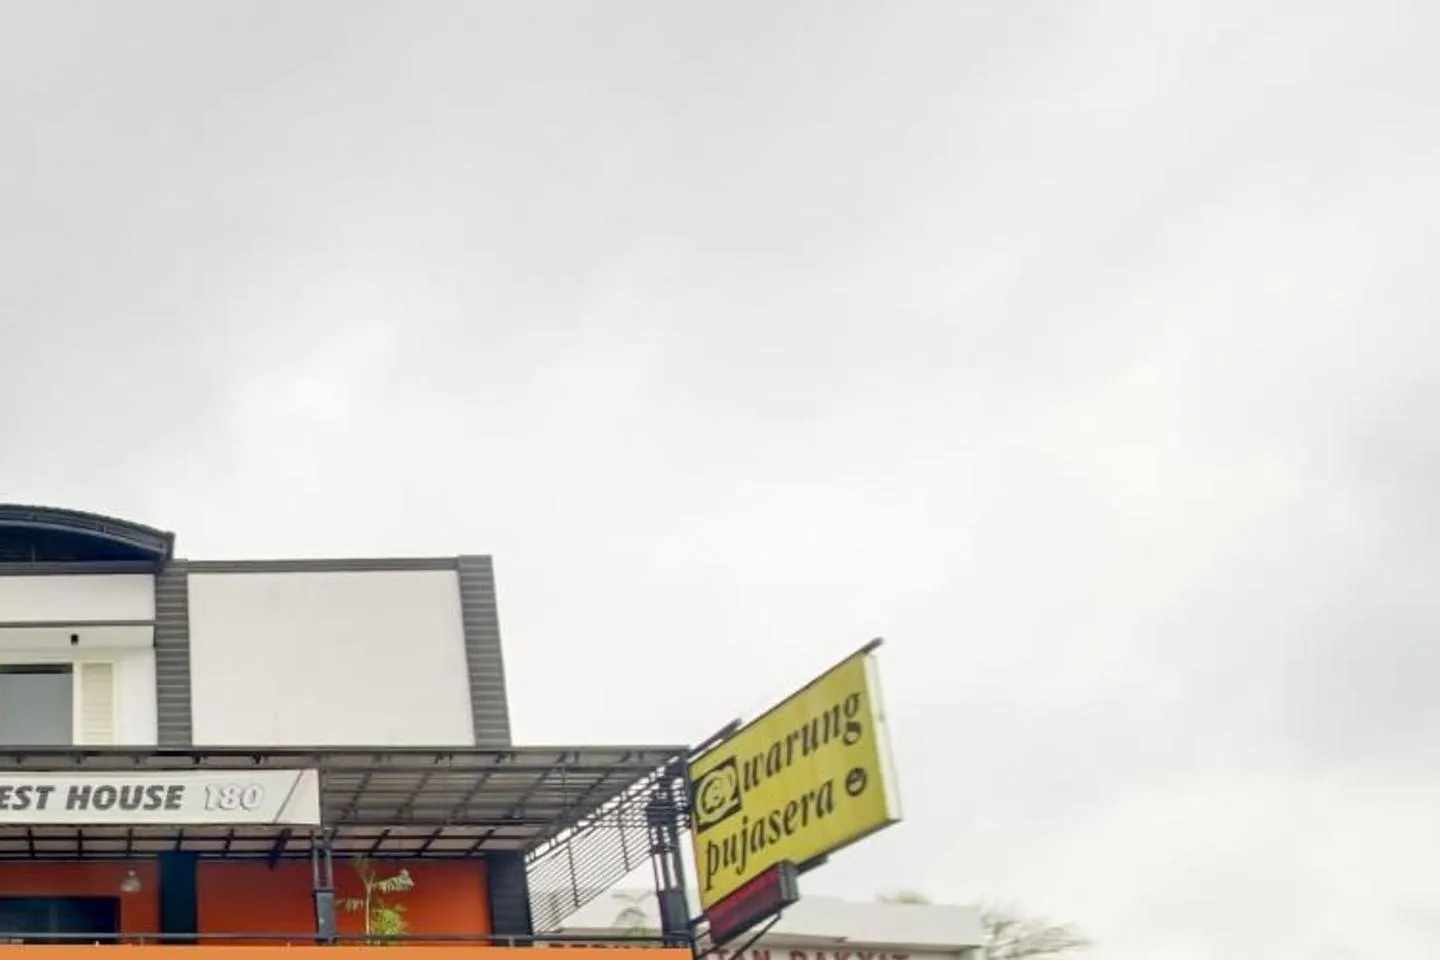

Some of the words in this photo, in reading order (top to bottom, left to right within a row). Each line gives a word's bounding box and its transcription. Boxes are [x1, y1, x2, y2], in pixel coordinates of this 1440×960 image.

[743, 691, 863, 792] warung
[65, 785, 185, 810] HOUSE
[203, 783, 265, 811] 180
[705, 778, 835, 891] pujasera
